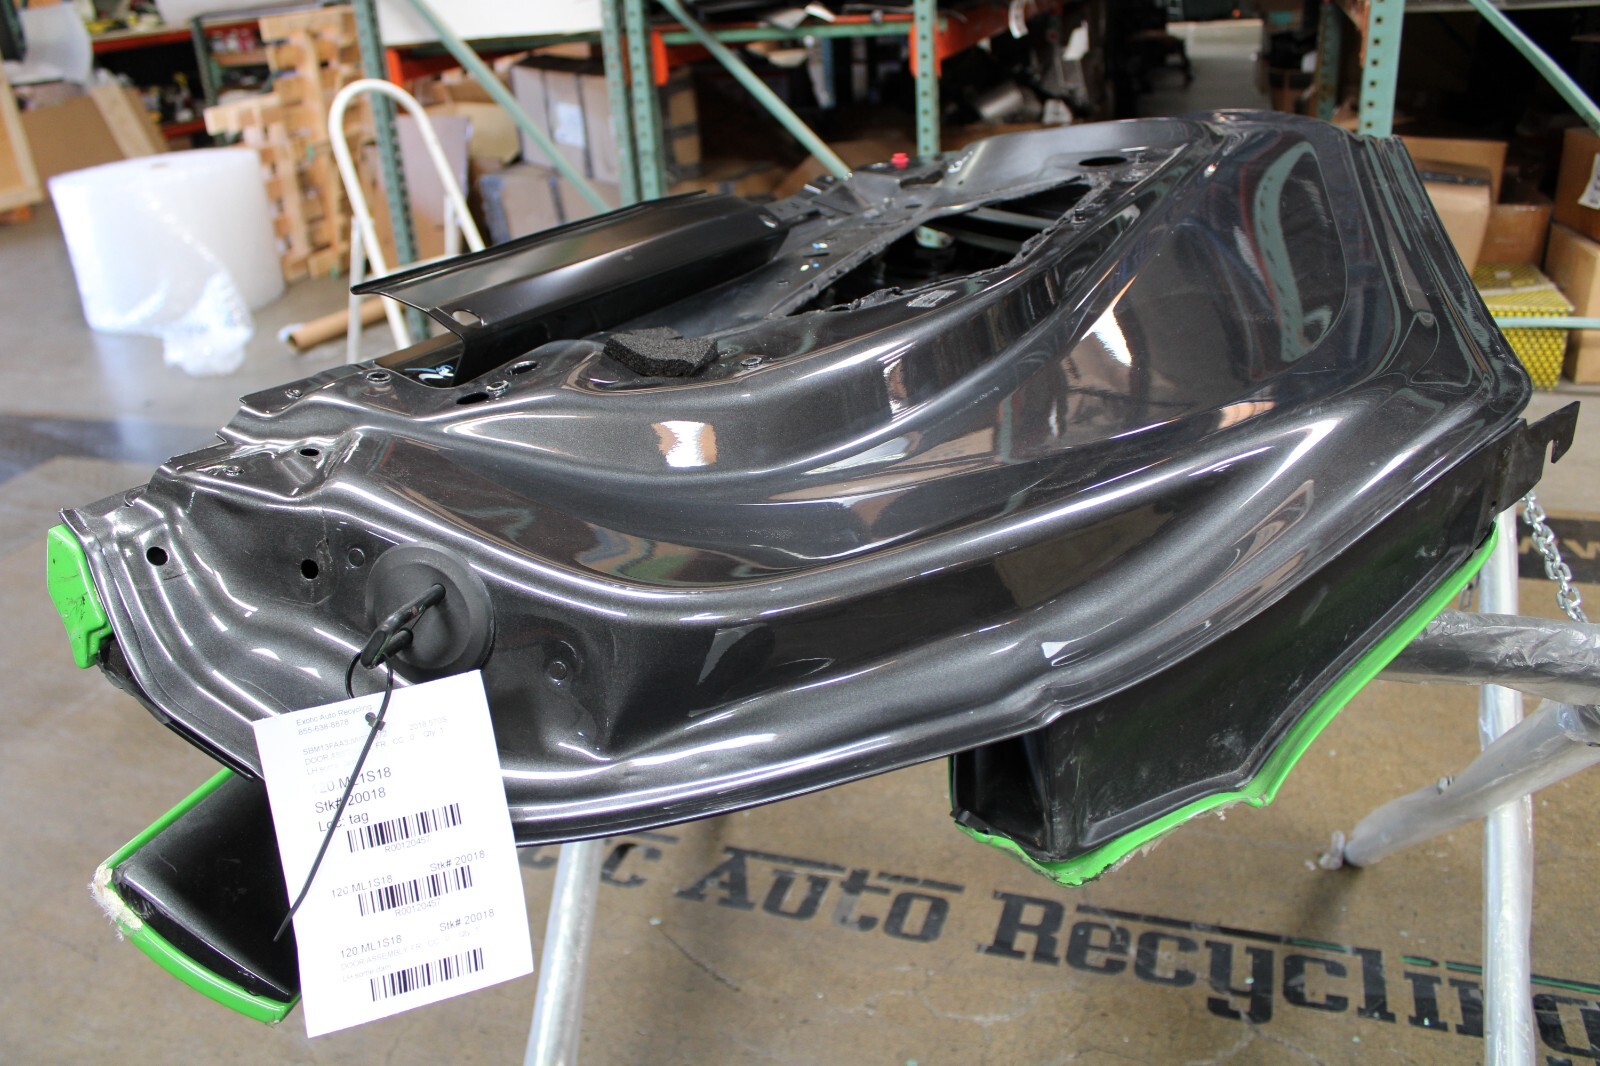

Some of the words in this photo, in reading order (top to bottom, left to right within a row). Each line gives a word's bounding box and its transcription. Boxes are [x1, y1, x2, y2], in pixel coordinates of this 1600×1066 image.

[319, 711, 336, 721] Auto
[348, 787, 386, 807] 20018
[349, 811, 369, 825] tag
[385, 835, 431, 853] R00120457
[430, 858, 452, 872] Stk#
[455, 850, 486, 867] 20018
[673, 846, 964, 943] Auto
[395, 898, 441, 917] R00120457
[439, 917, 462, 932] Stk#
[464, 909, 495, 925] 20018
